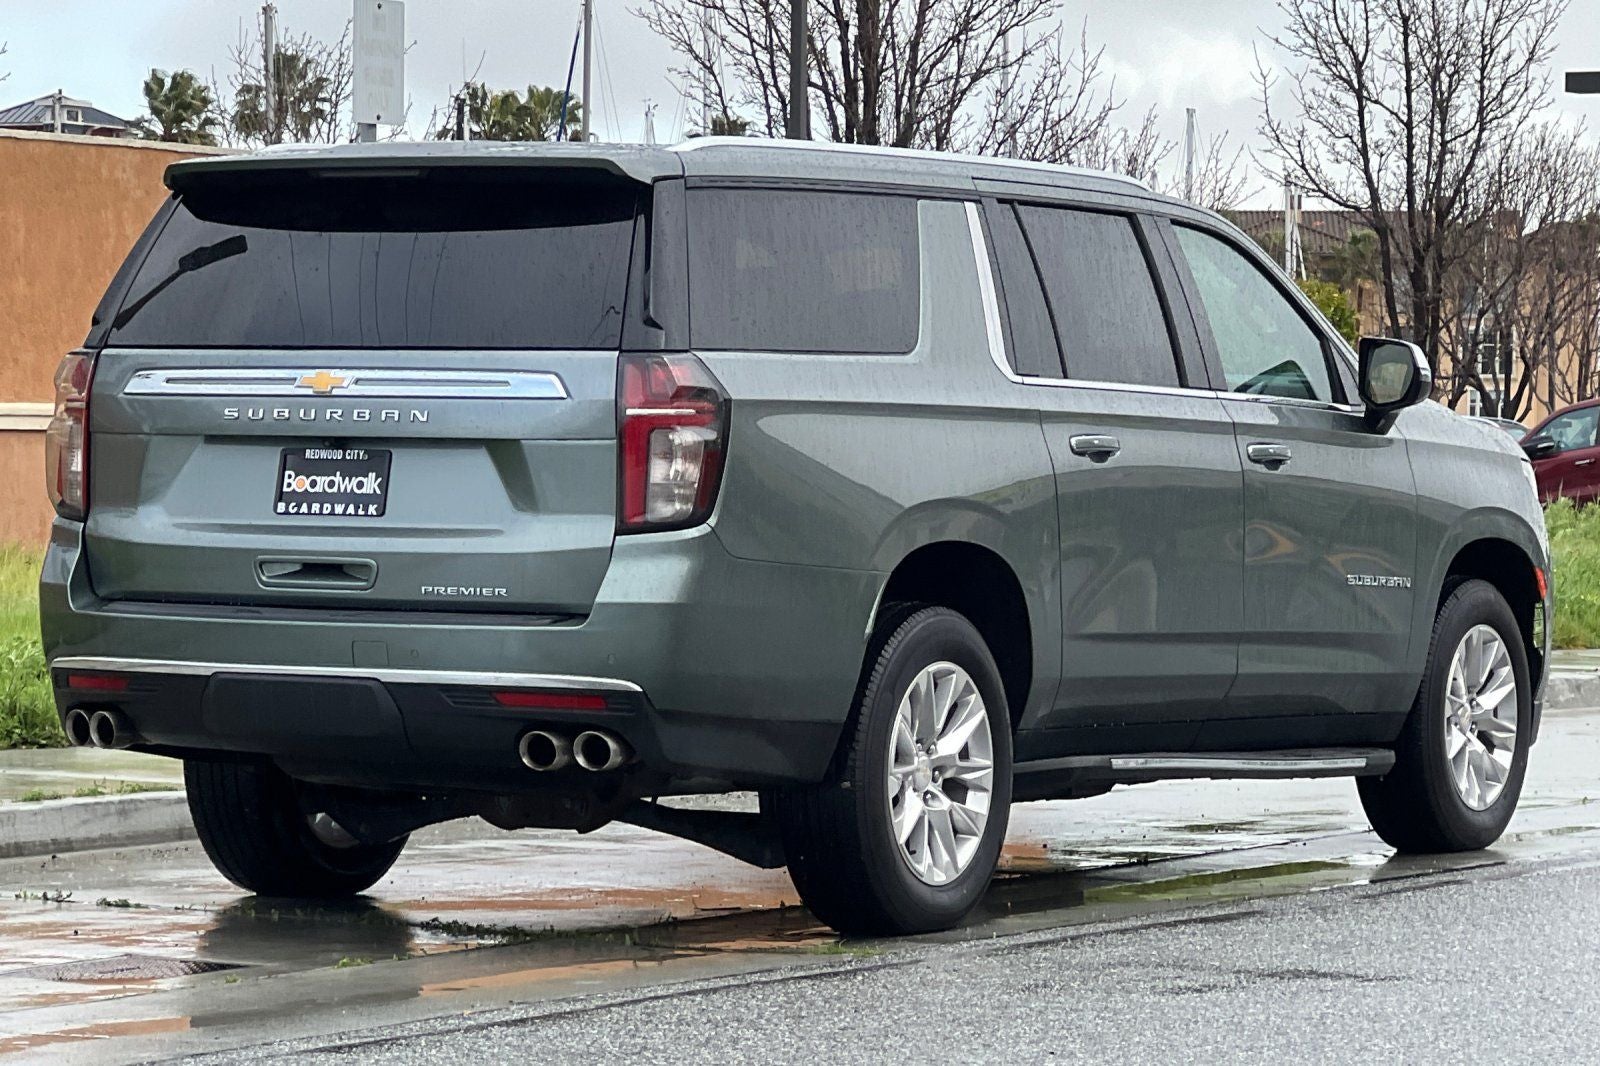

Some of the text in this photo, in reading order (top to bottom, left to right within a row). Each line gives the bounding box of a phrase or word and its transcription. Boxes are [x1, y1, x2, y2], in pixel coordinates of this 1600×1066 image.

[223, 407, 430, 423] SUBURBAN
[305, 448, 365, 460] REDWOOD CITY
[283, 470, 382, 494] Boardwalk
[276, 501, 378, 516] BOARDWALK
[1346, 574, 1412, 588] SUBURBAN
[421, 586, 508, 597] PREMIER
